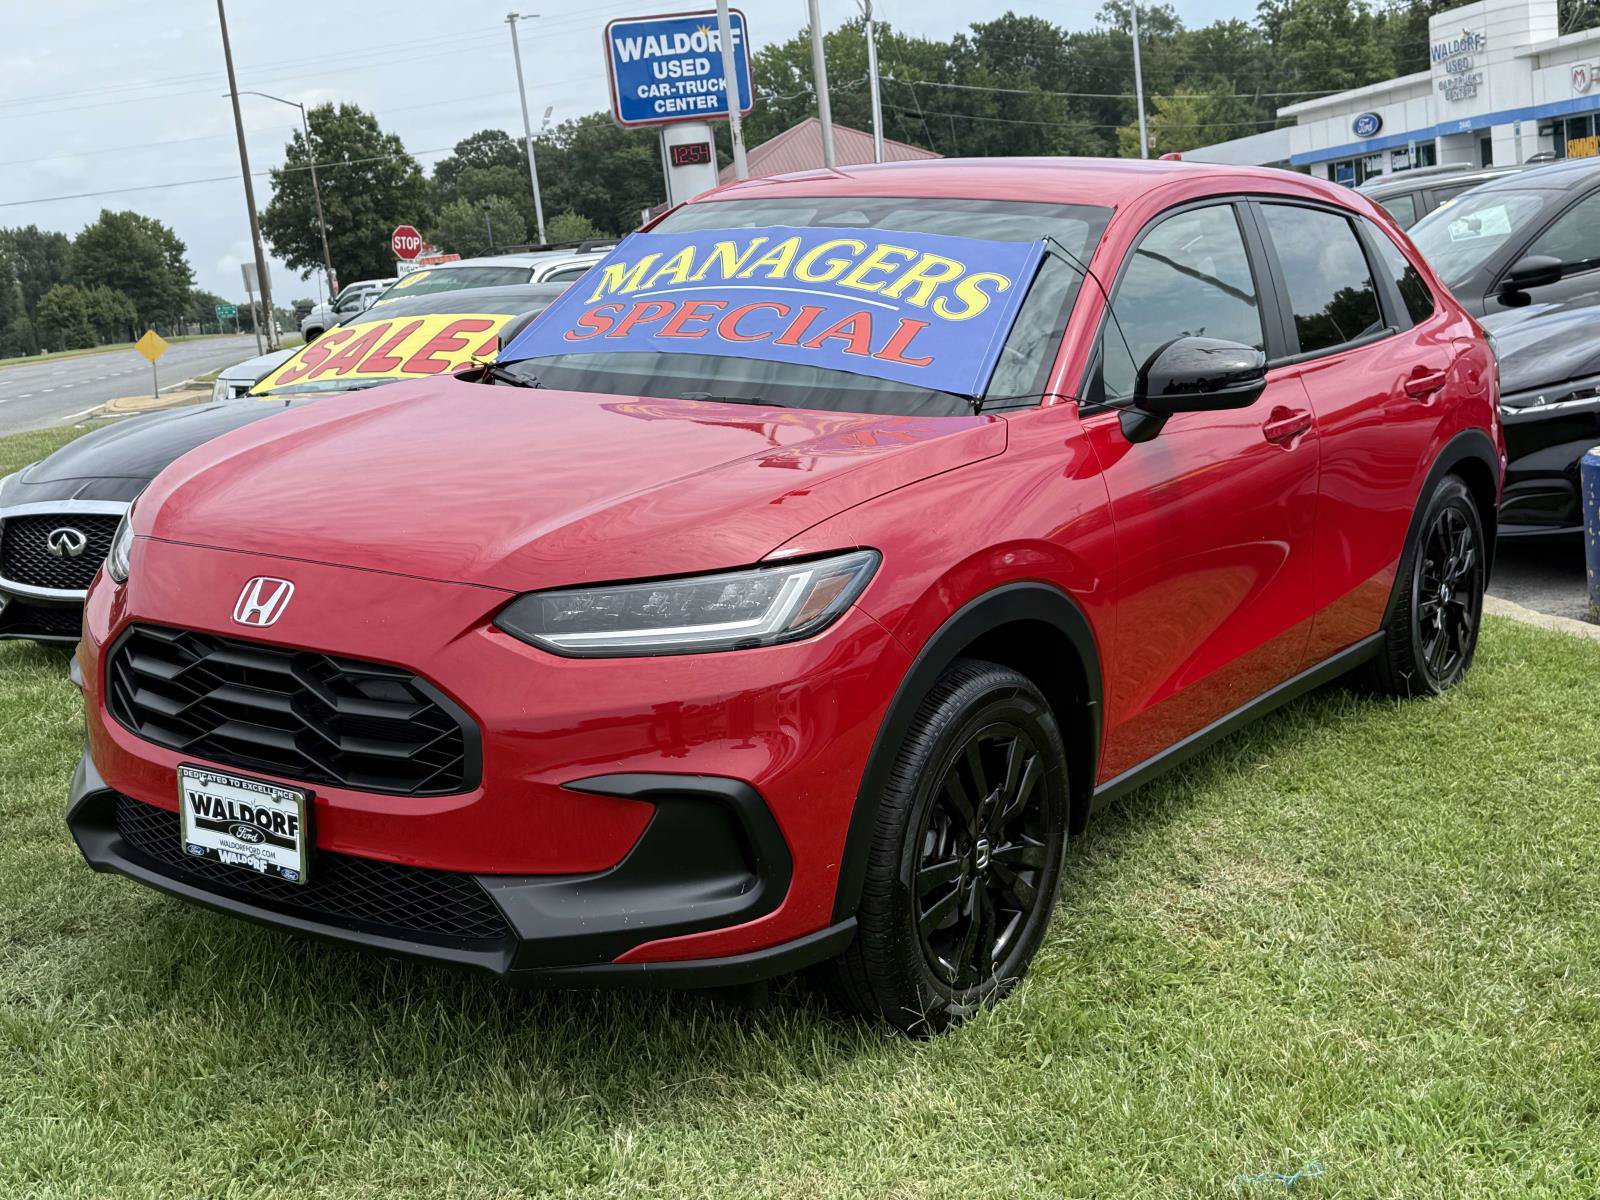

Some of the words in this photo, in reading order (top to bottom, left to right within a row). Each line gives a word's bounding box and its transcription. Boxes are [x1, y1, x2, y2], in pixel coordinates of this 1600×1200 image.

[615, 28, 740, 63] WALDORF
[653, 57, 710, 79] USED
[637, 78, 727, 98] CAR-TRUCK
[654, 95, 718, 113] CENTER
[394, 236, 420, 250] STOP
[585, 236, 1012, 321] MANAGERS
[563, 300, 935, 368] SPECIAL
[183, 769, 228, 785] DEDICATED
[230, 779, 240, 788] TO
[242, 782, 294, 801] EXCELLENCE
[187, 789, 299, 837] WALDORF
[236, 826, 258, 842] Ford
[217, 849, 268, 873] WALDORF
